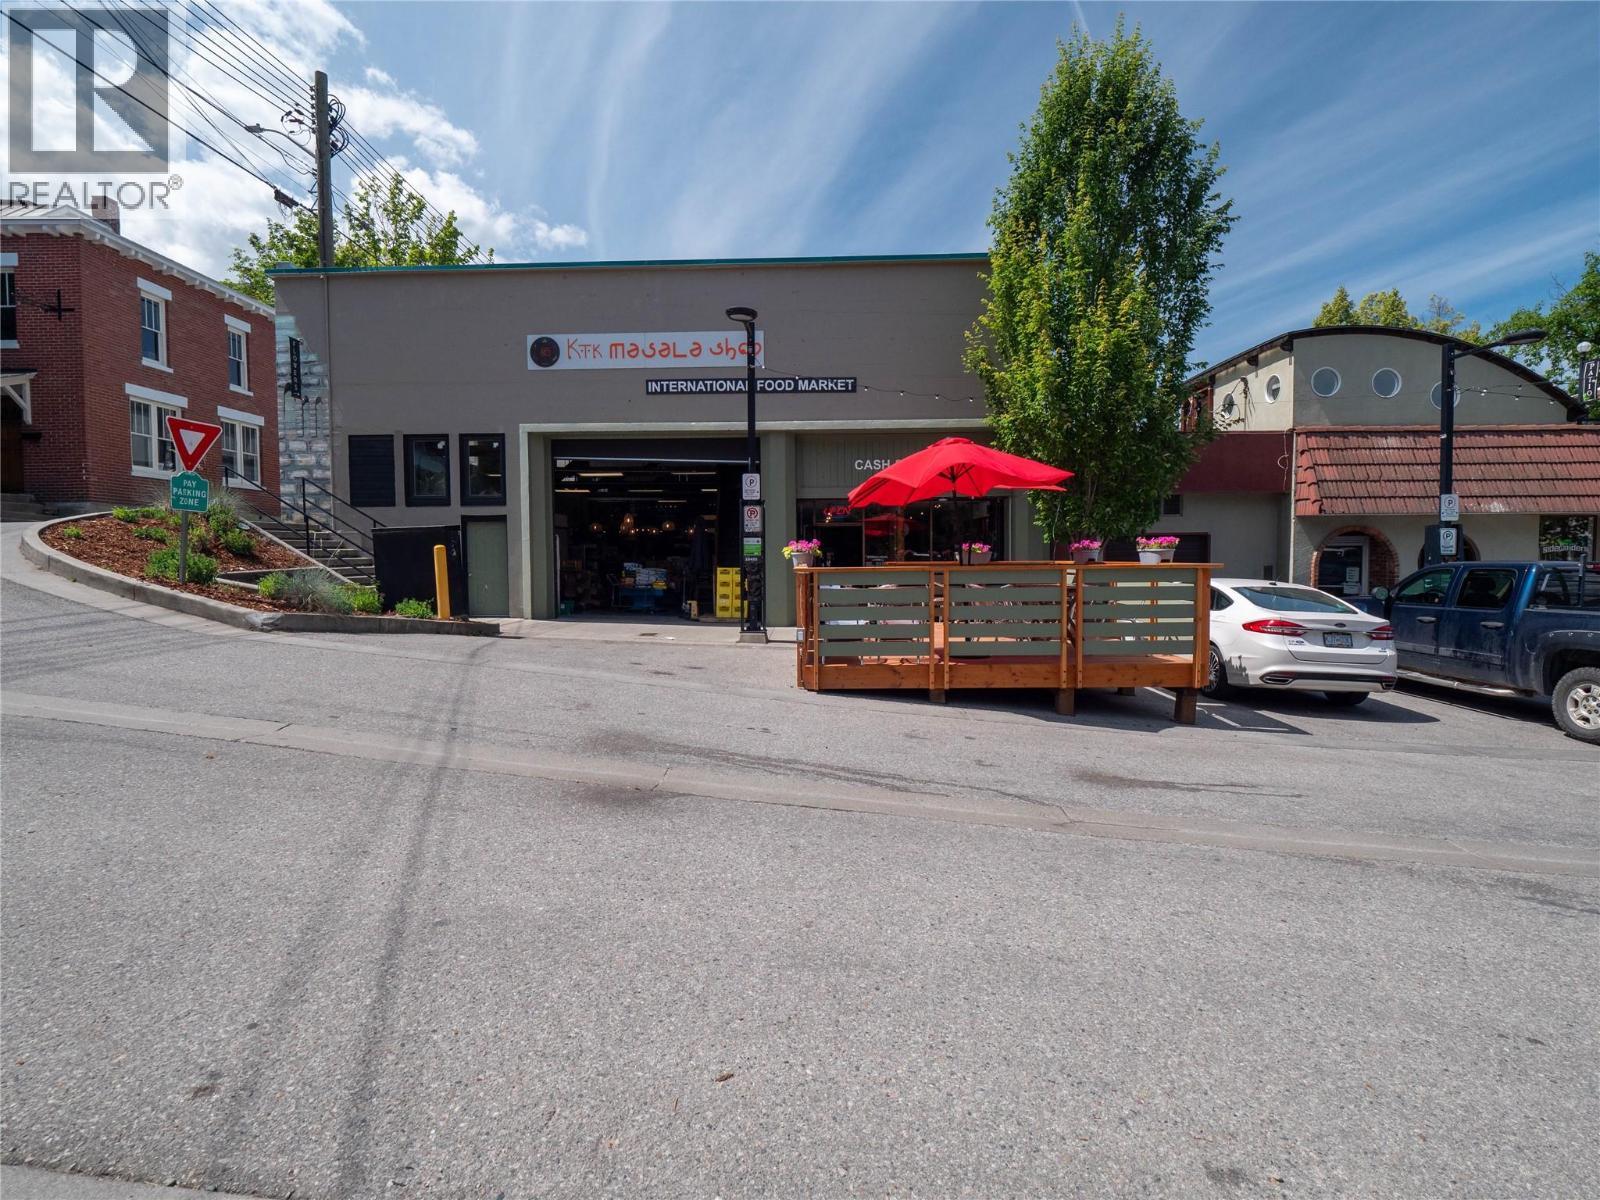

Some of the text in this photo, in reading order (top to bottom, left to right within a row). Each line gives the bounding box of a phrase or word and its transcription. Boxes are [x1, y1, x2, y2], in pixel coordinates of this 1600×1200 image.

[756, 379, 794, 391] FOOD
[798, 378, 854, 391] MARKET
[1586, 362, 1595, 396] PATIO
[854, 459, 890, 470] CASH
[183, 479, 197, 488] PAY
[173, 487, 207, 498] PARKING
[179, 497, 200, 506] ZONE
